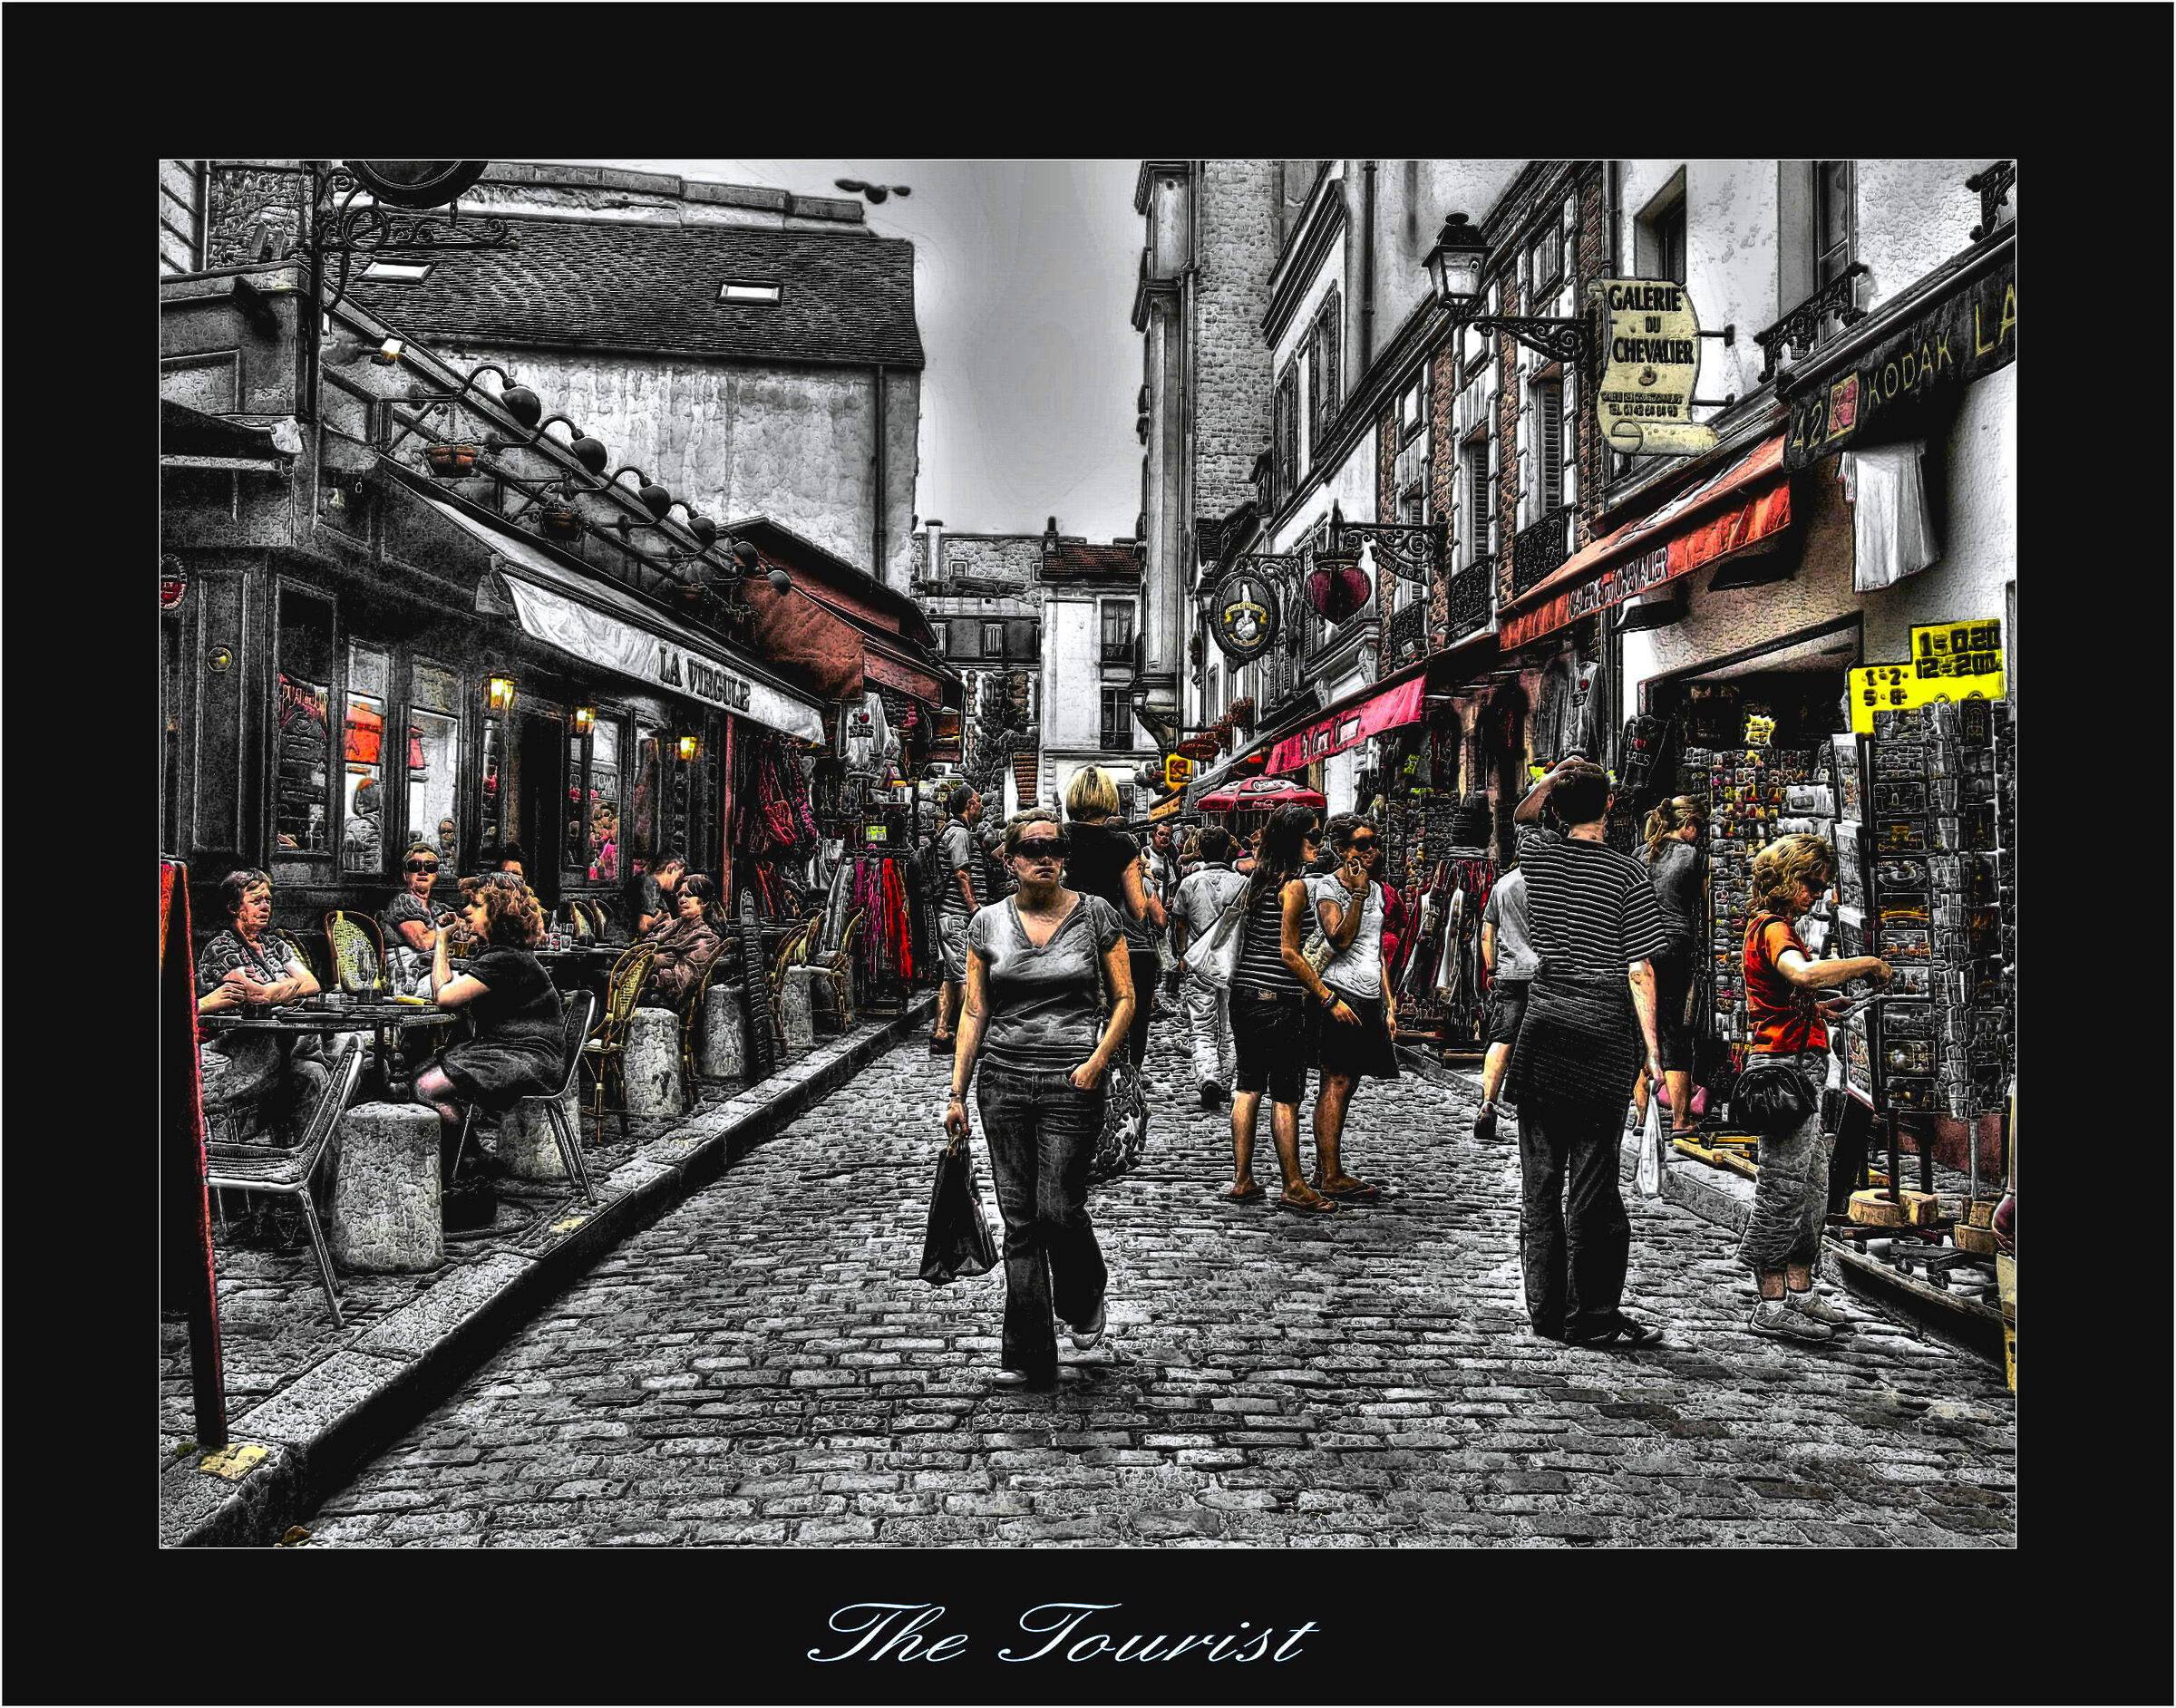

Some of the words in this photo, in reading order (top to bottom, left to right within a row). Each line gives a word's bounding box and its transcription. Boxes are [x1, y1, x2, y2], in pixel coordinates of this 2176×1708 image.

[1608, 284, 1682, 311] GALERIE
[1645, 315, 1661, 333] DU
[1612, 336, 1695, 364] CHEVALIER
[1867, 327, 1953, 409] KODAK
[659, 645, 682, 687] LA
[687, 657, 751, 713] VIRGULE
